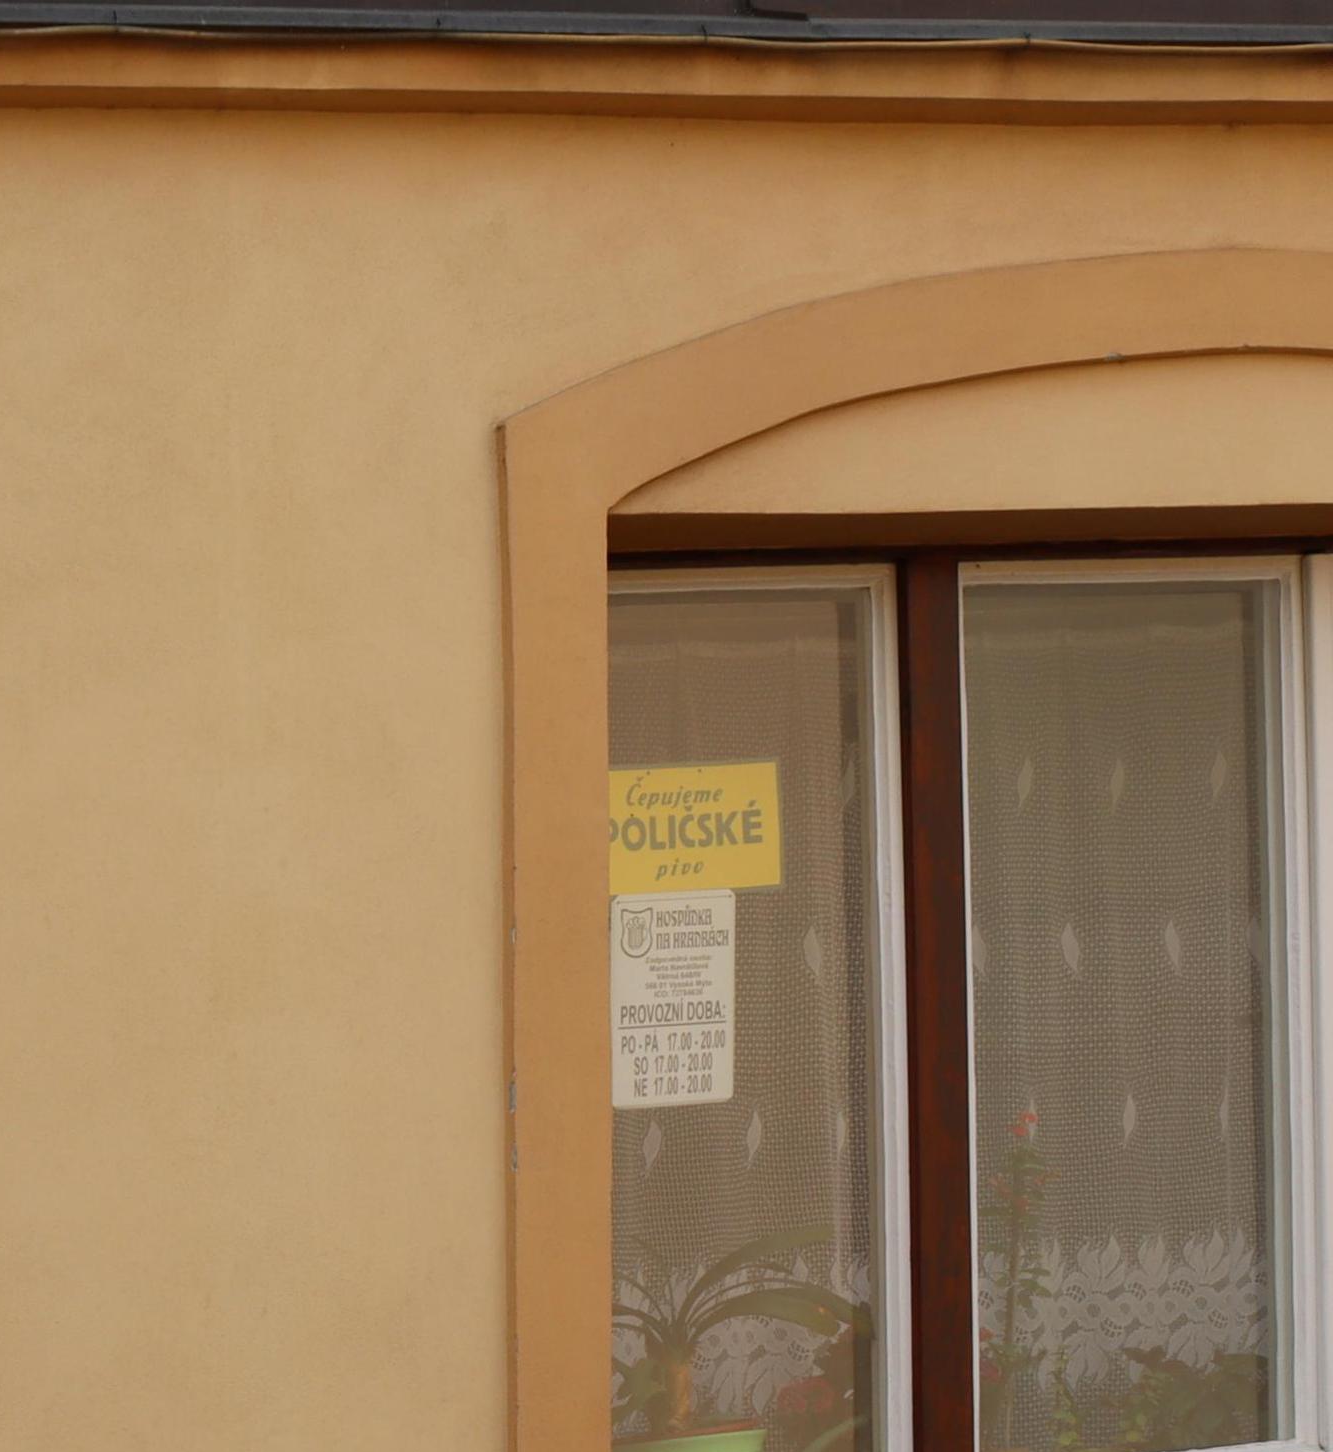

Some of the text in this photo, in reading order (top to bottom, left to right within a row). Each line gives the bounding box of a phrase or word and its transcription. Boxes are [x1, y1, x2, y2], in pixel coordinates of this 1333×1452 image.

[626, 776, 723, 810] Čepujeme
[655, 858, 704, 881] pivo
[656, 904, 713, 928] HOSPŮDKA
[656, 925, 730, 950] NA HRADBÁCH
[620, 998, 726, 1025] PROVOZNÍ DOBA:
[633, 1056, 649, 1076] SO
[633, 1077, 648, 1098] NE
